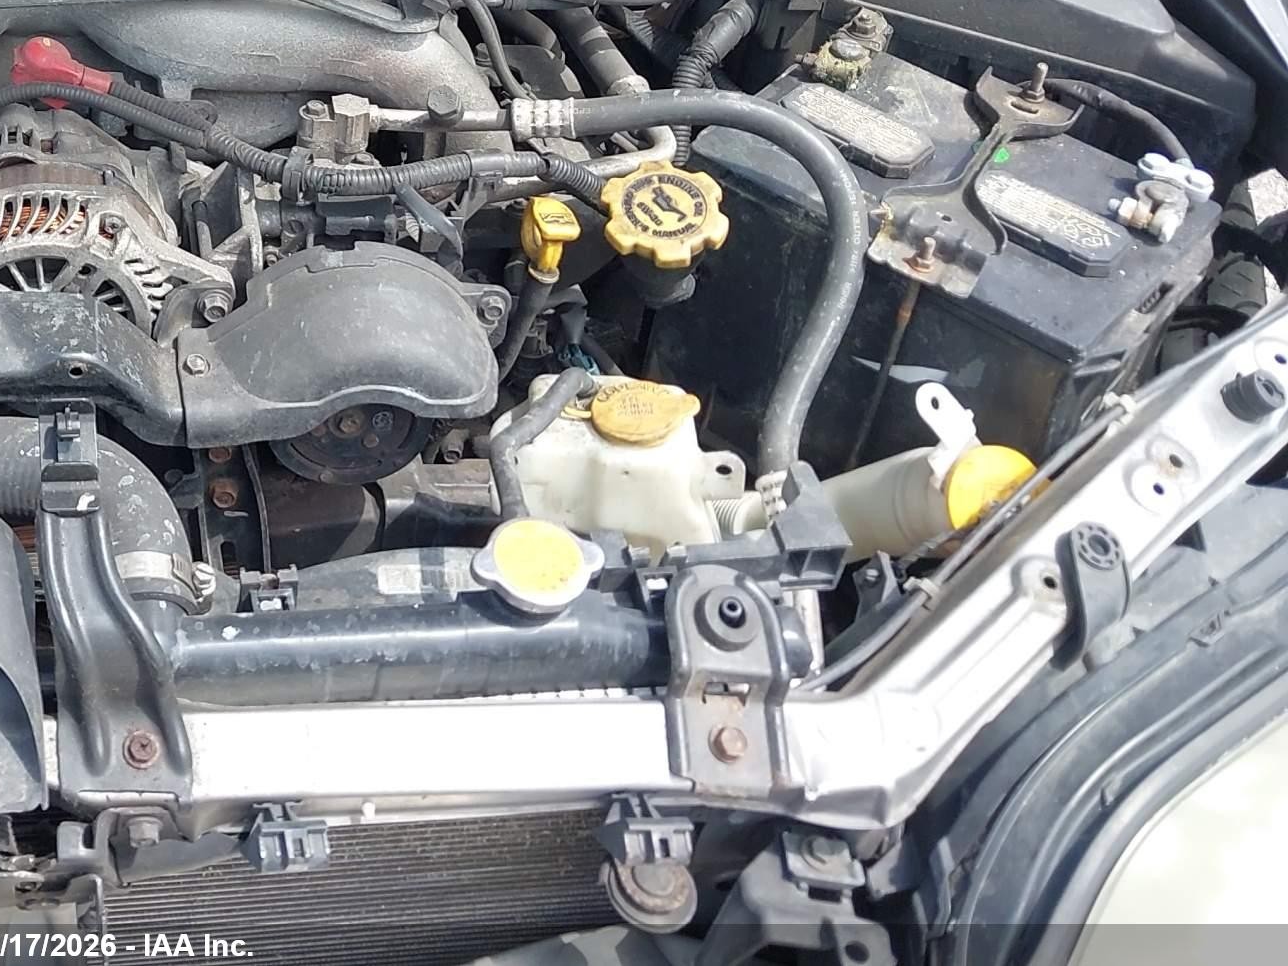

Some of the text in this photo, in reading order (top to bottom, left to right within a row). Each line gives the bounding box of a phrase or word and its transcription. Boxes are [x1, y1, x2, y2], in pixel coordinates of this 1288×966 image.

[658, 174, 700, 200] ENGINE
[693, 201, 703, 217] OIL
[853, 211, 862, 245] OUTER
